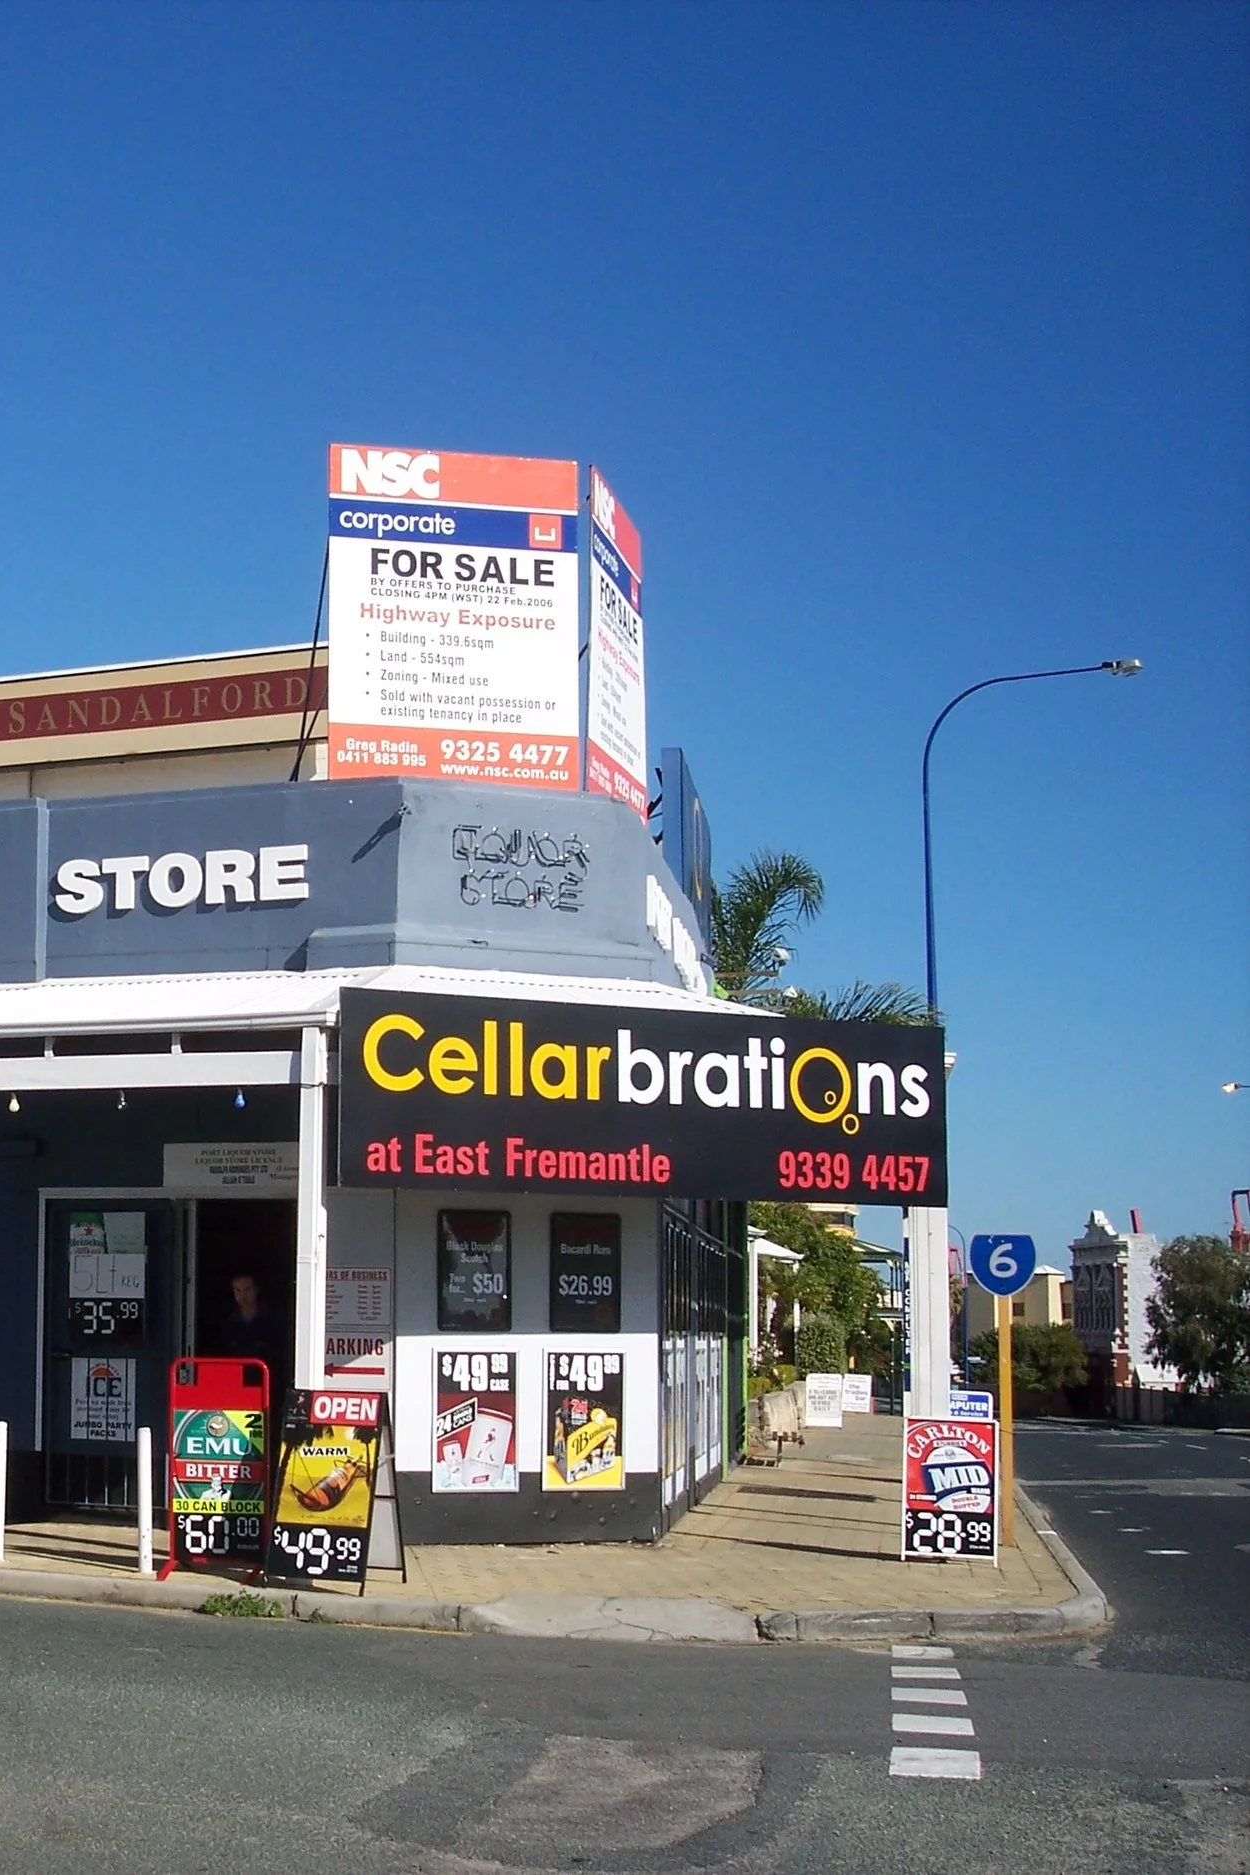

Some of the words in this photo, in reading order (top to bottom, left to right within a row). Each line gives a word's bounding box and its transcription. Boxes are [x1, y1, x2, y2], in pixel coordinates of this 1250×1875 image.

[340, 449, 440, 499] NSC
[339, 511, 456, 537] corporate
[371, 548, 443, 580] FOR
[454, 554, 555, 587] SALE
[370, 578, 384, 586] BY
[389, 579, 432, 589] OFFERS
[439, 582, 451, 590] TO
[455, 583, 516, 595] PURCHASE
[370, 588, 420, 599] CLOSING
[425, 591, 447, 600] 4PM
[451, 593, 483, 604] (WST)
[487, 595, 500, 604] 22
[360, 602, 450, 628] Highway
[458, 609, 556, 631] Exposure
[600, 577, 616, 613] FOR
[618, 599, 637, 645] SALE
[381, 631, 426, 647] Building
[439, 635, 494, 650] 339.6sqm
[381, 650, 407, 663] Land
[420, 653, 465, 667] 554sqm
[381, 669, 418, 684] Zoning
[431, 672, 465, 685] Mixed
[469, 677, 489, 687] use
[7, 676, 308, 735] SANDALFORD
[381, 689, 405, 702] Sold
[409, 692, 433, 704] with
[437, 694, 474, 706] vacant
[479, 696, 541, 711] possession
[545, 701, 556, 711] or
[381, 706, 425, 720] existing
[430, 708, 473, 723] tenancy
[477, 710, 488, 721] in
[492, 711, 522, 724] place
[346, 738, 376, 753] Greg
[381, 739, 418, 754] Radin
[440, 739, 500, 762] 9325
[509, 742, 569, 766] 4477
[337, 752, 369, 764] 0411
[440, 763, 569, 781] www.nsc.com.au
[55, 844, 310, 915] STORE
[362, 1014, 930, 1125] Cellarbrations
[222, 1149, 251, 1157] LIQUOR
[366, 1138, 401, 1174] at
[414, 1133, 489, 1176] East
[505, 1137, 671, 1183] Fremantle
[778, 1150, 850, 1190] 9339
[861, 1153, 930, 1192] 4457
[446, 1241, 468, 1251] Black
[471, 1241, 504, 1253] Douglas
[561, 1243, 591, 1255] Bacardi
[593, 1244, 611, 1255] Rum
[460, 1253, 488, 1264] Scotch
[989, 1243, 1018, 1278] 6
[121, 1275, 140, 1288] KEG
[340, 1271, 349, 1279] OF
[352, 1271, 387, 1280] BUSINESS
[449, 1273, 465, 1283] Two
[473, 1273, 503, 1294] $50
[559, 1274, 612, 1296] $26.99
[75, 1302, 138, 1334] $35.99
[326, 1338, 383, 1355] ARKING
[314, 1396, 379, 1421] OPEN
[244, 1413, 262, 1429] 2
[249, 1430, 262, 1438] FOR
[907, 1424, 991, 1459] CARLTON
[187, 1437, 250, 1456] EMU
[302, 1447, 348, 1456] WARM
[186, 1463, 251, 1479] BITTER
[928, 1465, 990, 1493] MID
[176, 1501, 189, 1511] 30
[192, 1501, 217, 1511] CAN
[221, 1501, 261, 1512] BLOCK
[907, 1511, 991, 1554] $28.99
[274, 1526, 361, 1575] $49.99
